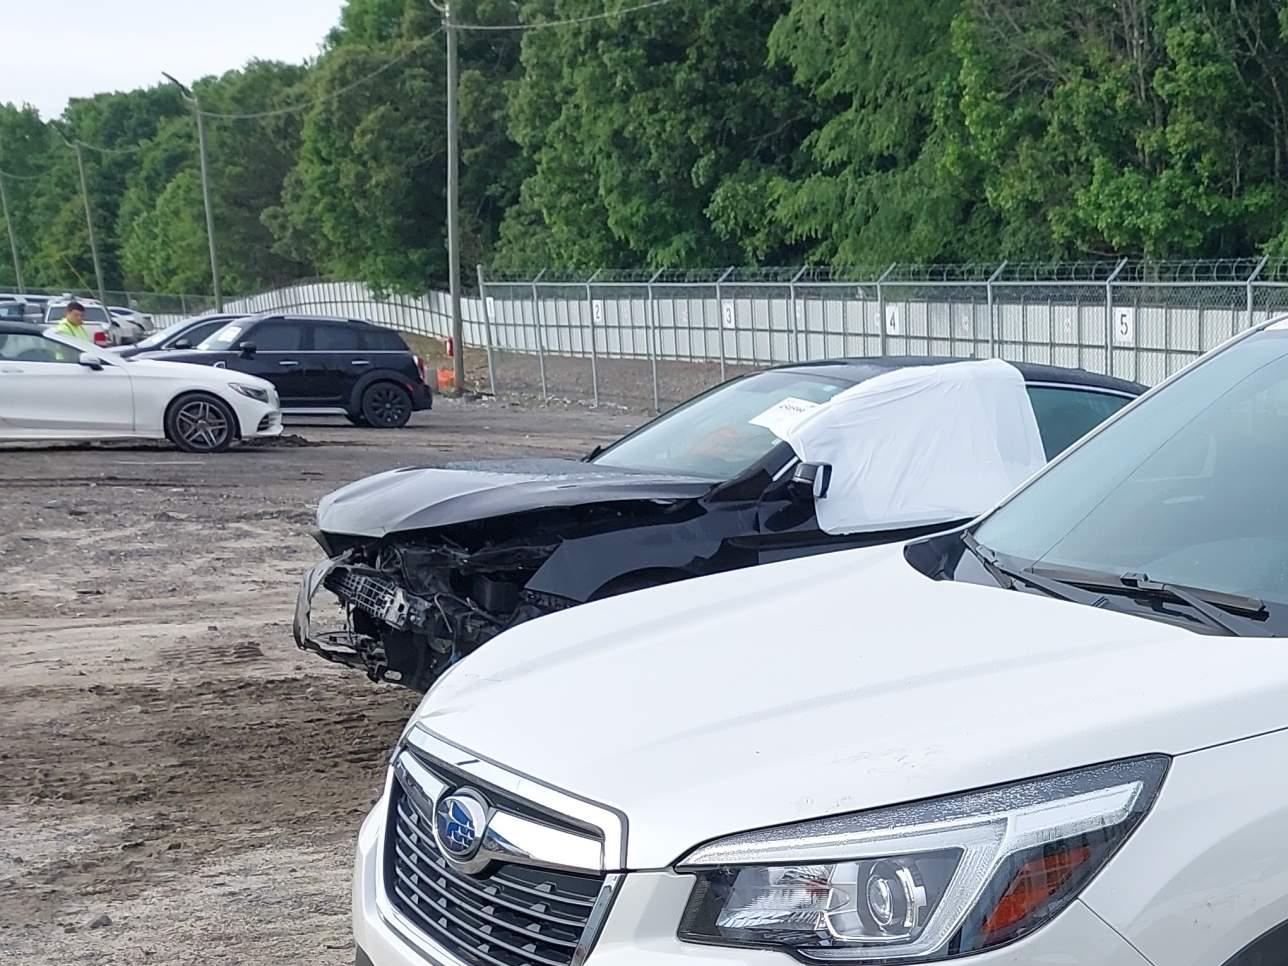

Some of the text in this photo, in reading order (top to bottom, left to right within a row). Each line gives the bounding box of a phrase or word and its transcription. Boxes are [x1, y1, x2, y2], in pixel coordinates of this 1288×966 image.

[595, 304, 601, 321] 2
[725, 307, 732, 324] 3
[889, 311, 896, 331] 4
[1119, 313, 1128, 336] 5
